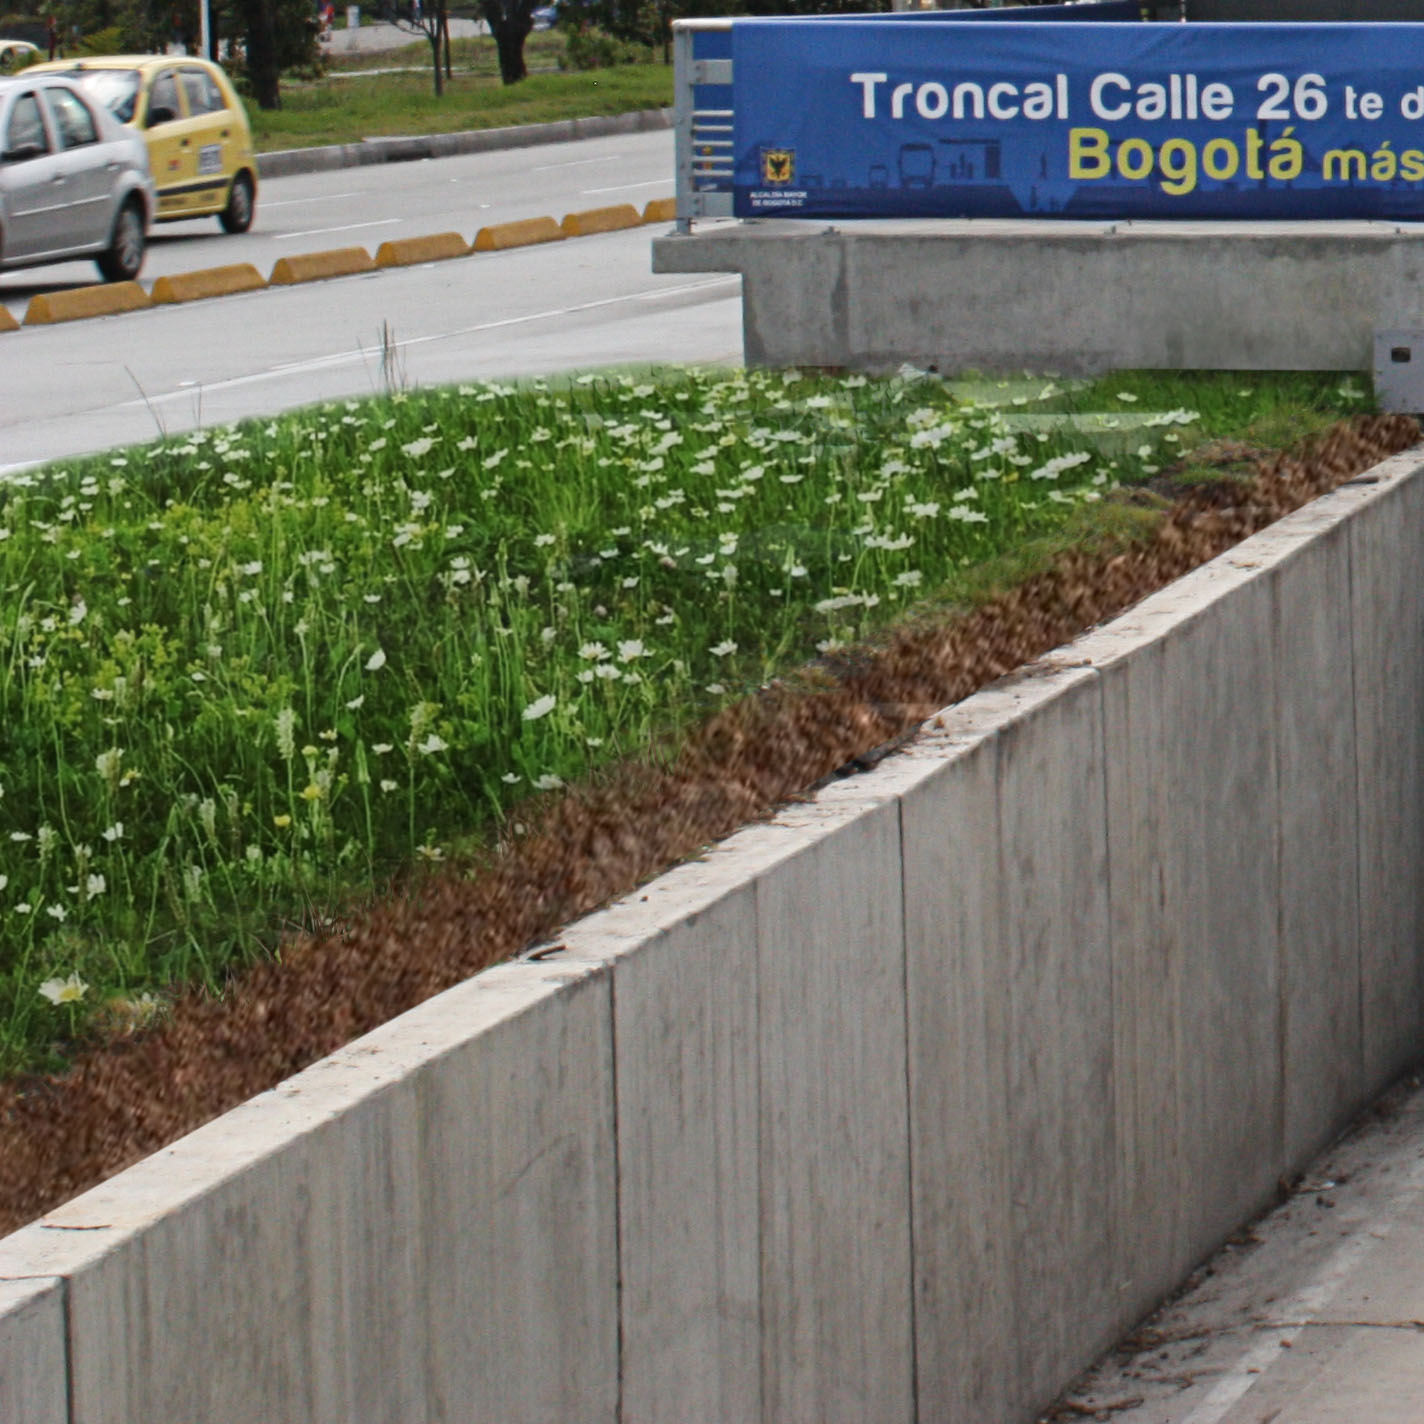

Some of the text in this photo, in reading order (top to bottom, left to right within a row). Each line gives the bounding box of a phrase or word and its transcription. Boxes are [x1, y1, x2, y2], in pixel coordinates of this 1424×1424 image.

[850, 72, 1068, 120] Troncal
[1090, 72, 1234, 121] Calle
[1256, 73, 1328, 121] 26
[1345, 85, 1384, 120] te
[1068, 126, 1302, 196] Bogotá
